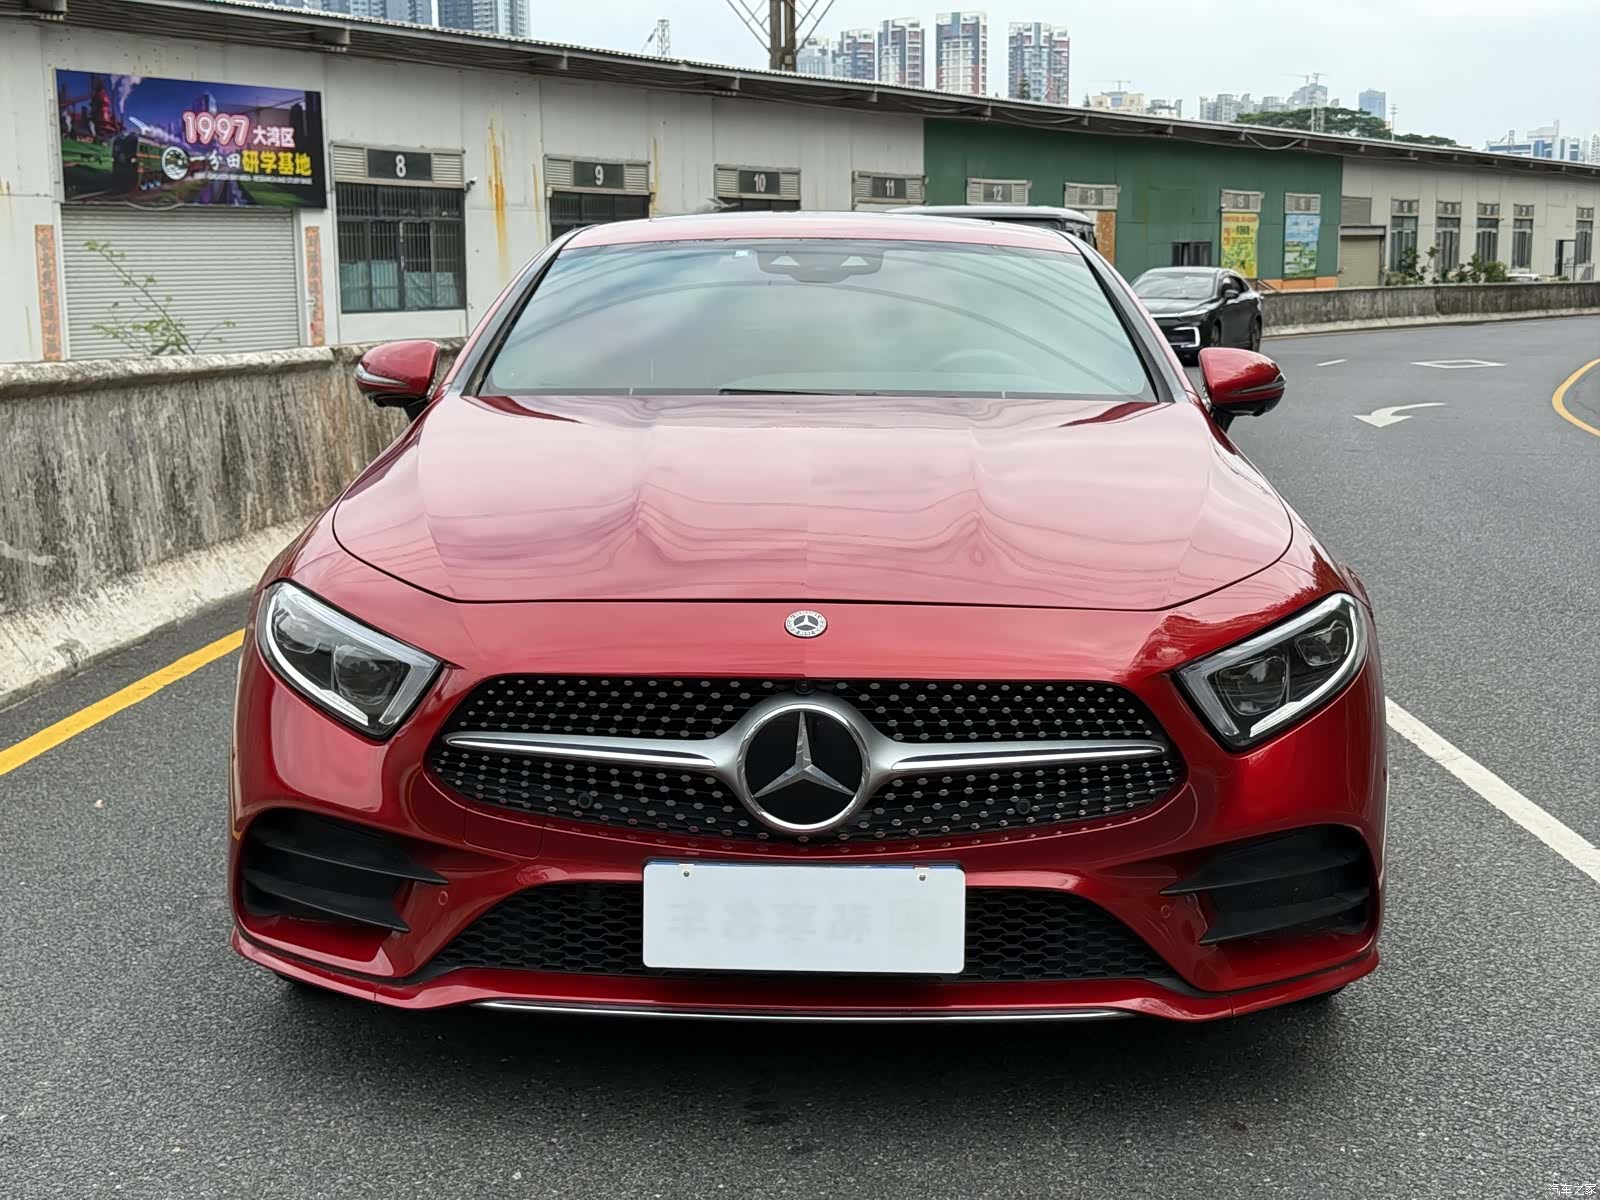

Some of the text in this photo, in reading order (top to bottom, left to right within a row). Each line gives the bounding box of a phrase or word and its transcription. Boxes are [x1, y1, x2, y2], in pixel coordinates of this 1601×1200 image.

[183, 112, 295, 147] 1997 大湾区
[396, 154, 406, 178] 8
[595, 165, 604, 186] 9
[753, 174, 767, 192] 10
[885, 179, 895, 197] 11
[993, 185, 1003, 201] 12
